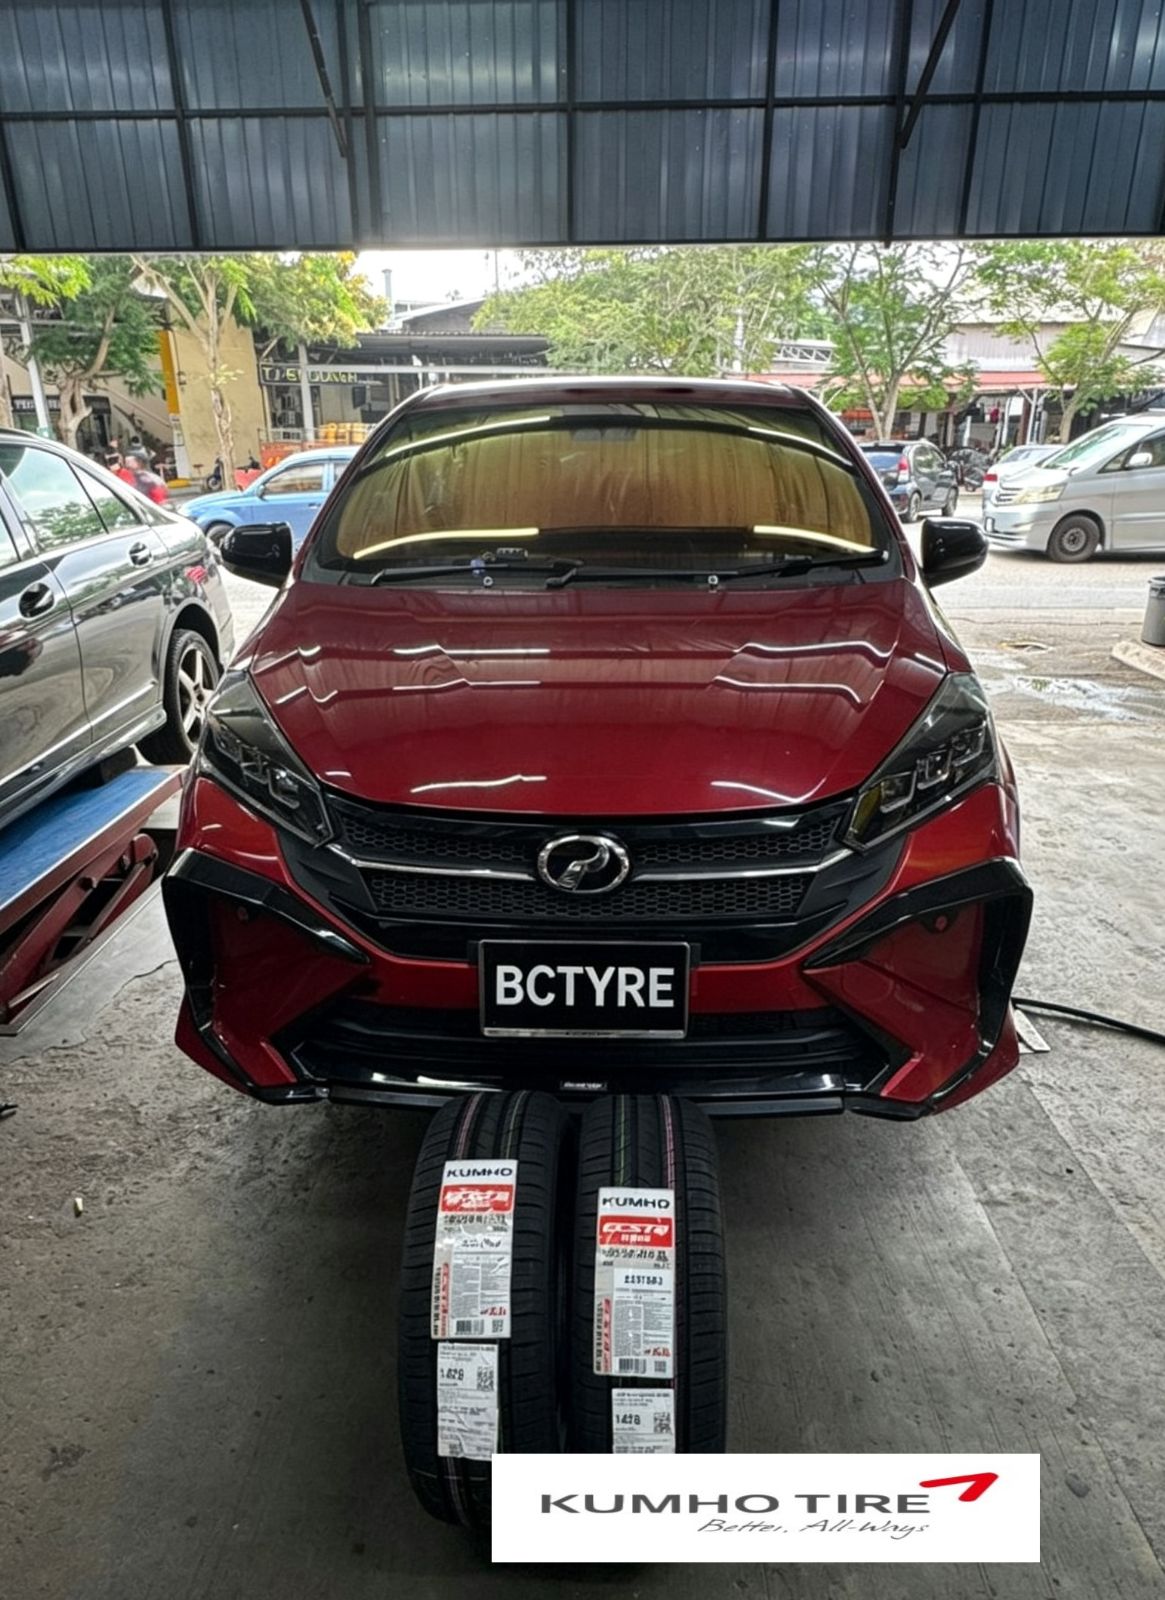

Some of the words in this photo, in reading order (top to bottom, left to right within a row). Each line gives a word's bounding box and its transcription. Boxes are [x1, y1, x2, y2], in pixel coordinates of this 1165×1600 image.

[496, 964, 675, 1007] BCTYRE
[446, 1167, 513, 1178] KUMHO
[602, 1196, 671, 1209] KUMHO
